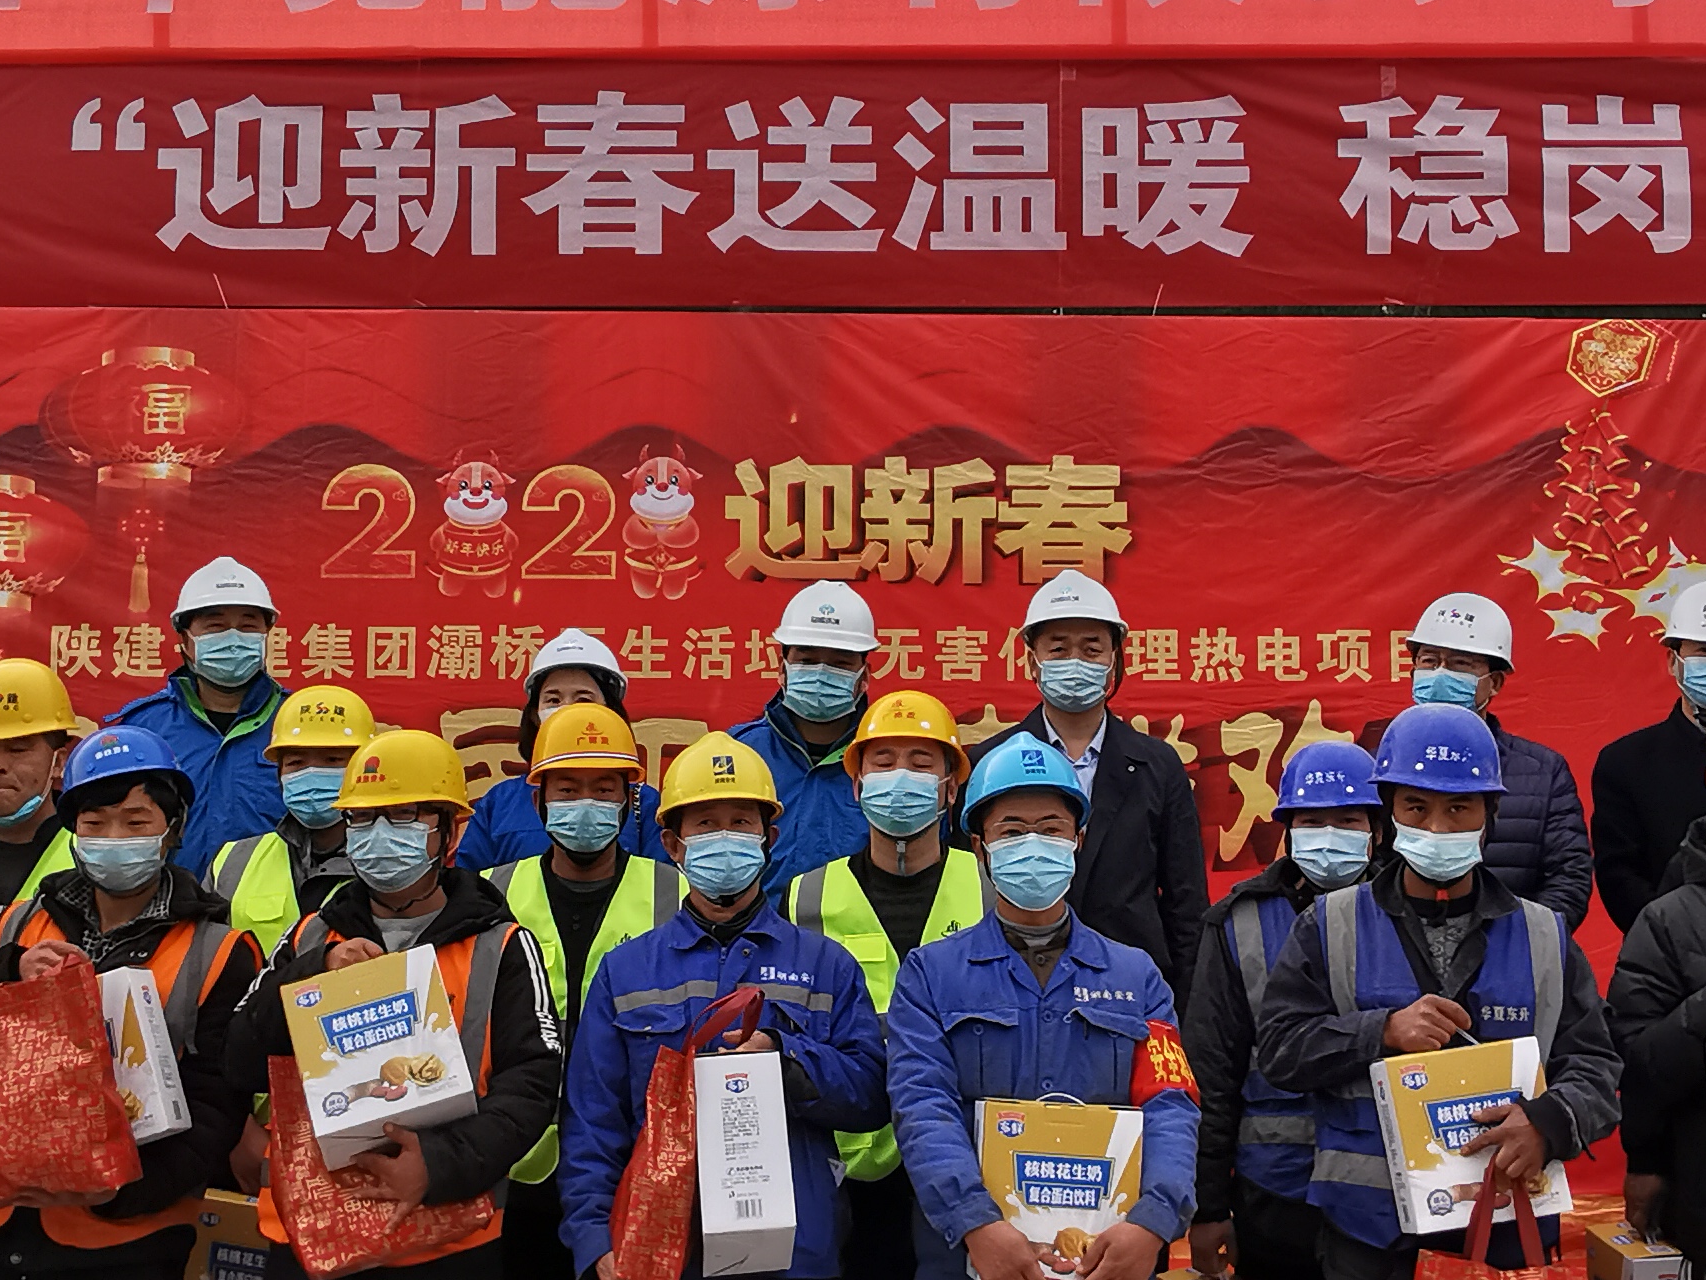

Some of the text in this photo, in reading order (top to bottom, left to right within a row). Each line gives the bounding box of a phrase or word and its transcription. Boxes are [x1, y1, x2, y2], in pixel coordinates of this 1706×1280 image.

[725, 455, 1132, 584] 迎新春
[445, 539, 505, 557] 新年快乐
[332, 999, 409, 1033] 核桃花生奶
[1481, 1005, 1530, 1022] 华夏东升
[1024, 1160, 1103, 1183] 核桃花生奶
[216, 1245, 266, 1268] 核桃花生
